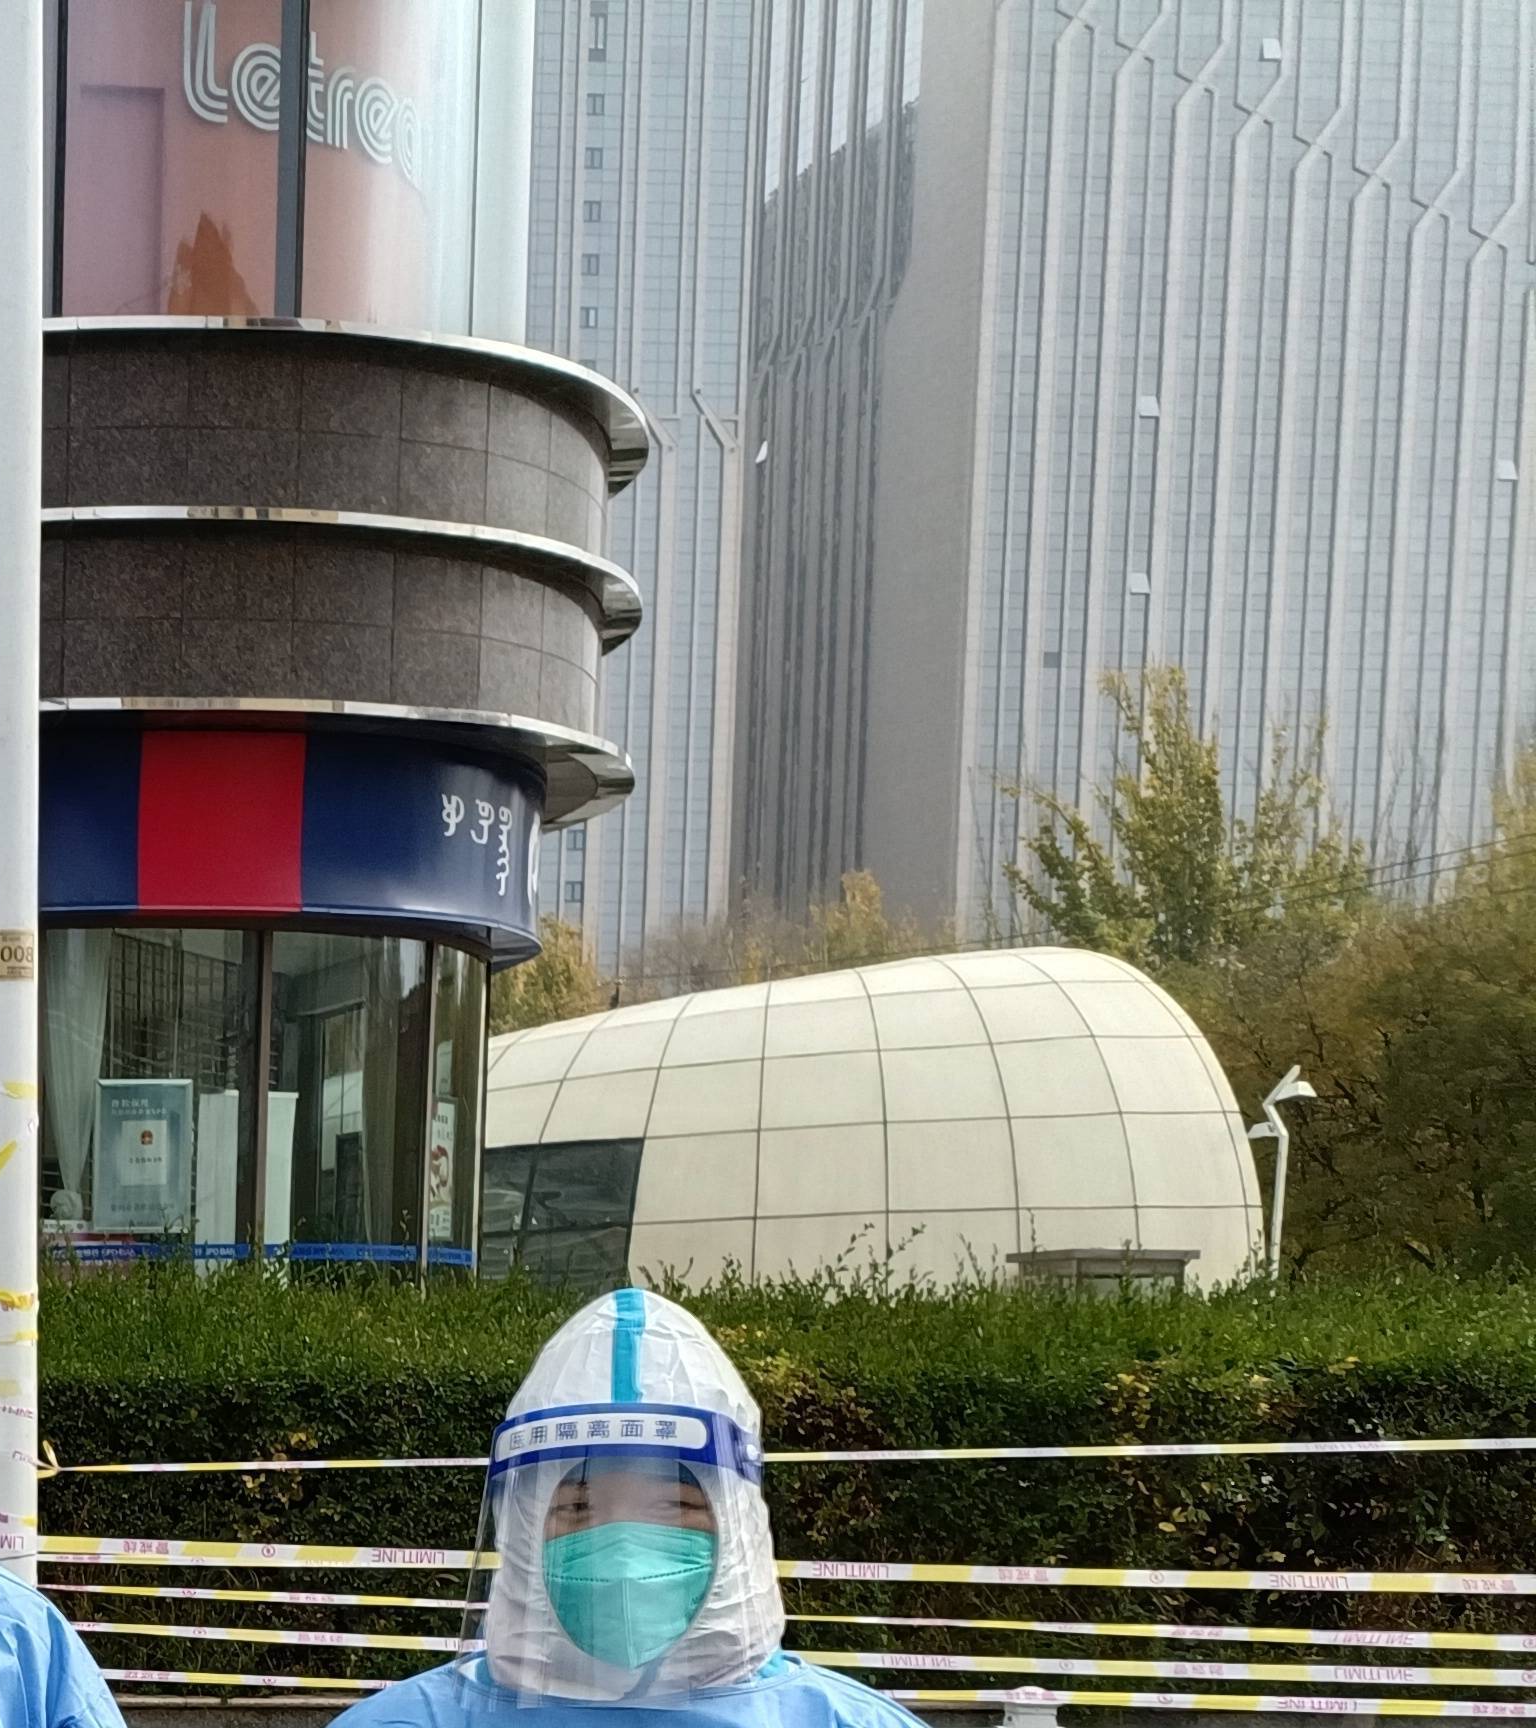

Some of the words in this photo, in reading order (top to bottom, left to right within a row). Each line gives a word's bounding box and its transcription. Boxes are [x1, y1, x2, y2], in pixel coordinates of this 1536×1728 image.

[509, 1419, 678, 1451] 医用隔离面罩
[371, 1548, 446, 1566] LIMITLINE
[812, 1561, 890, 1579] LIMITLINE
[1269, 1573, 1350, 1591] LIMITLINE
